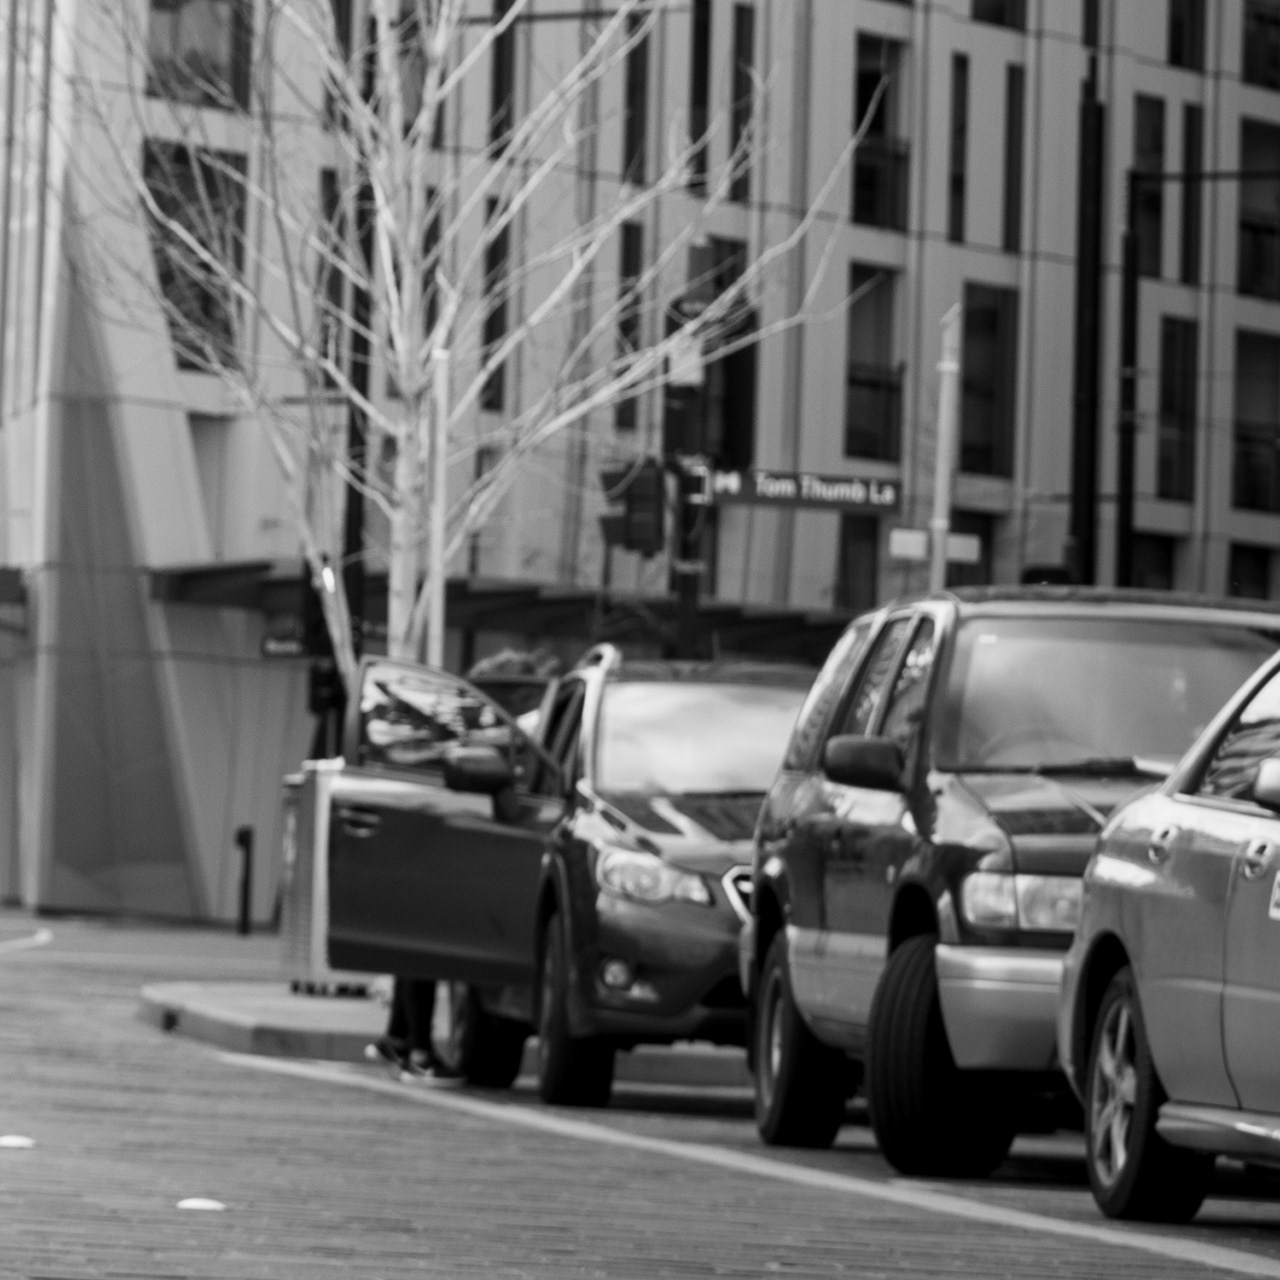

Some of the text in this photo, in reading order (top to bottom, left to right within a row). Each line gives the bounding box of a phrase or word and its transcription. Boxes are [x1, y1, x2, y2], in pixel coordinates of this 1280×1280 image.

[755, 472, 796, 498] Tom
[801, 474, 866, 503] Thumb
[869, 479, 896, 505] La
